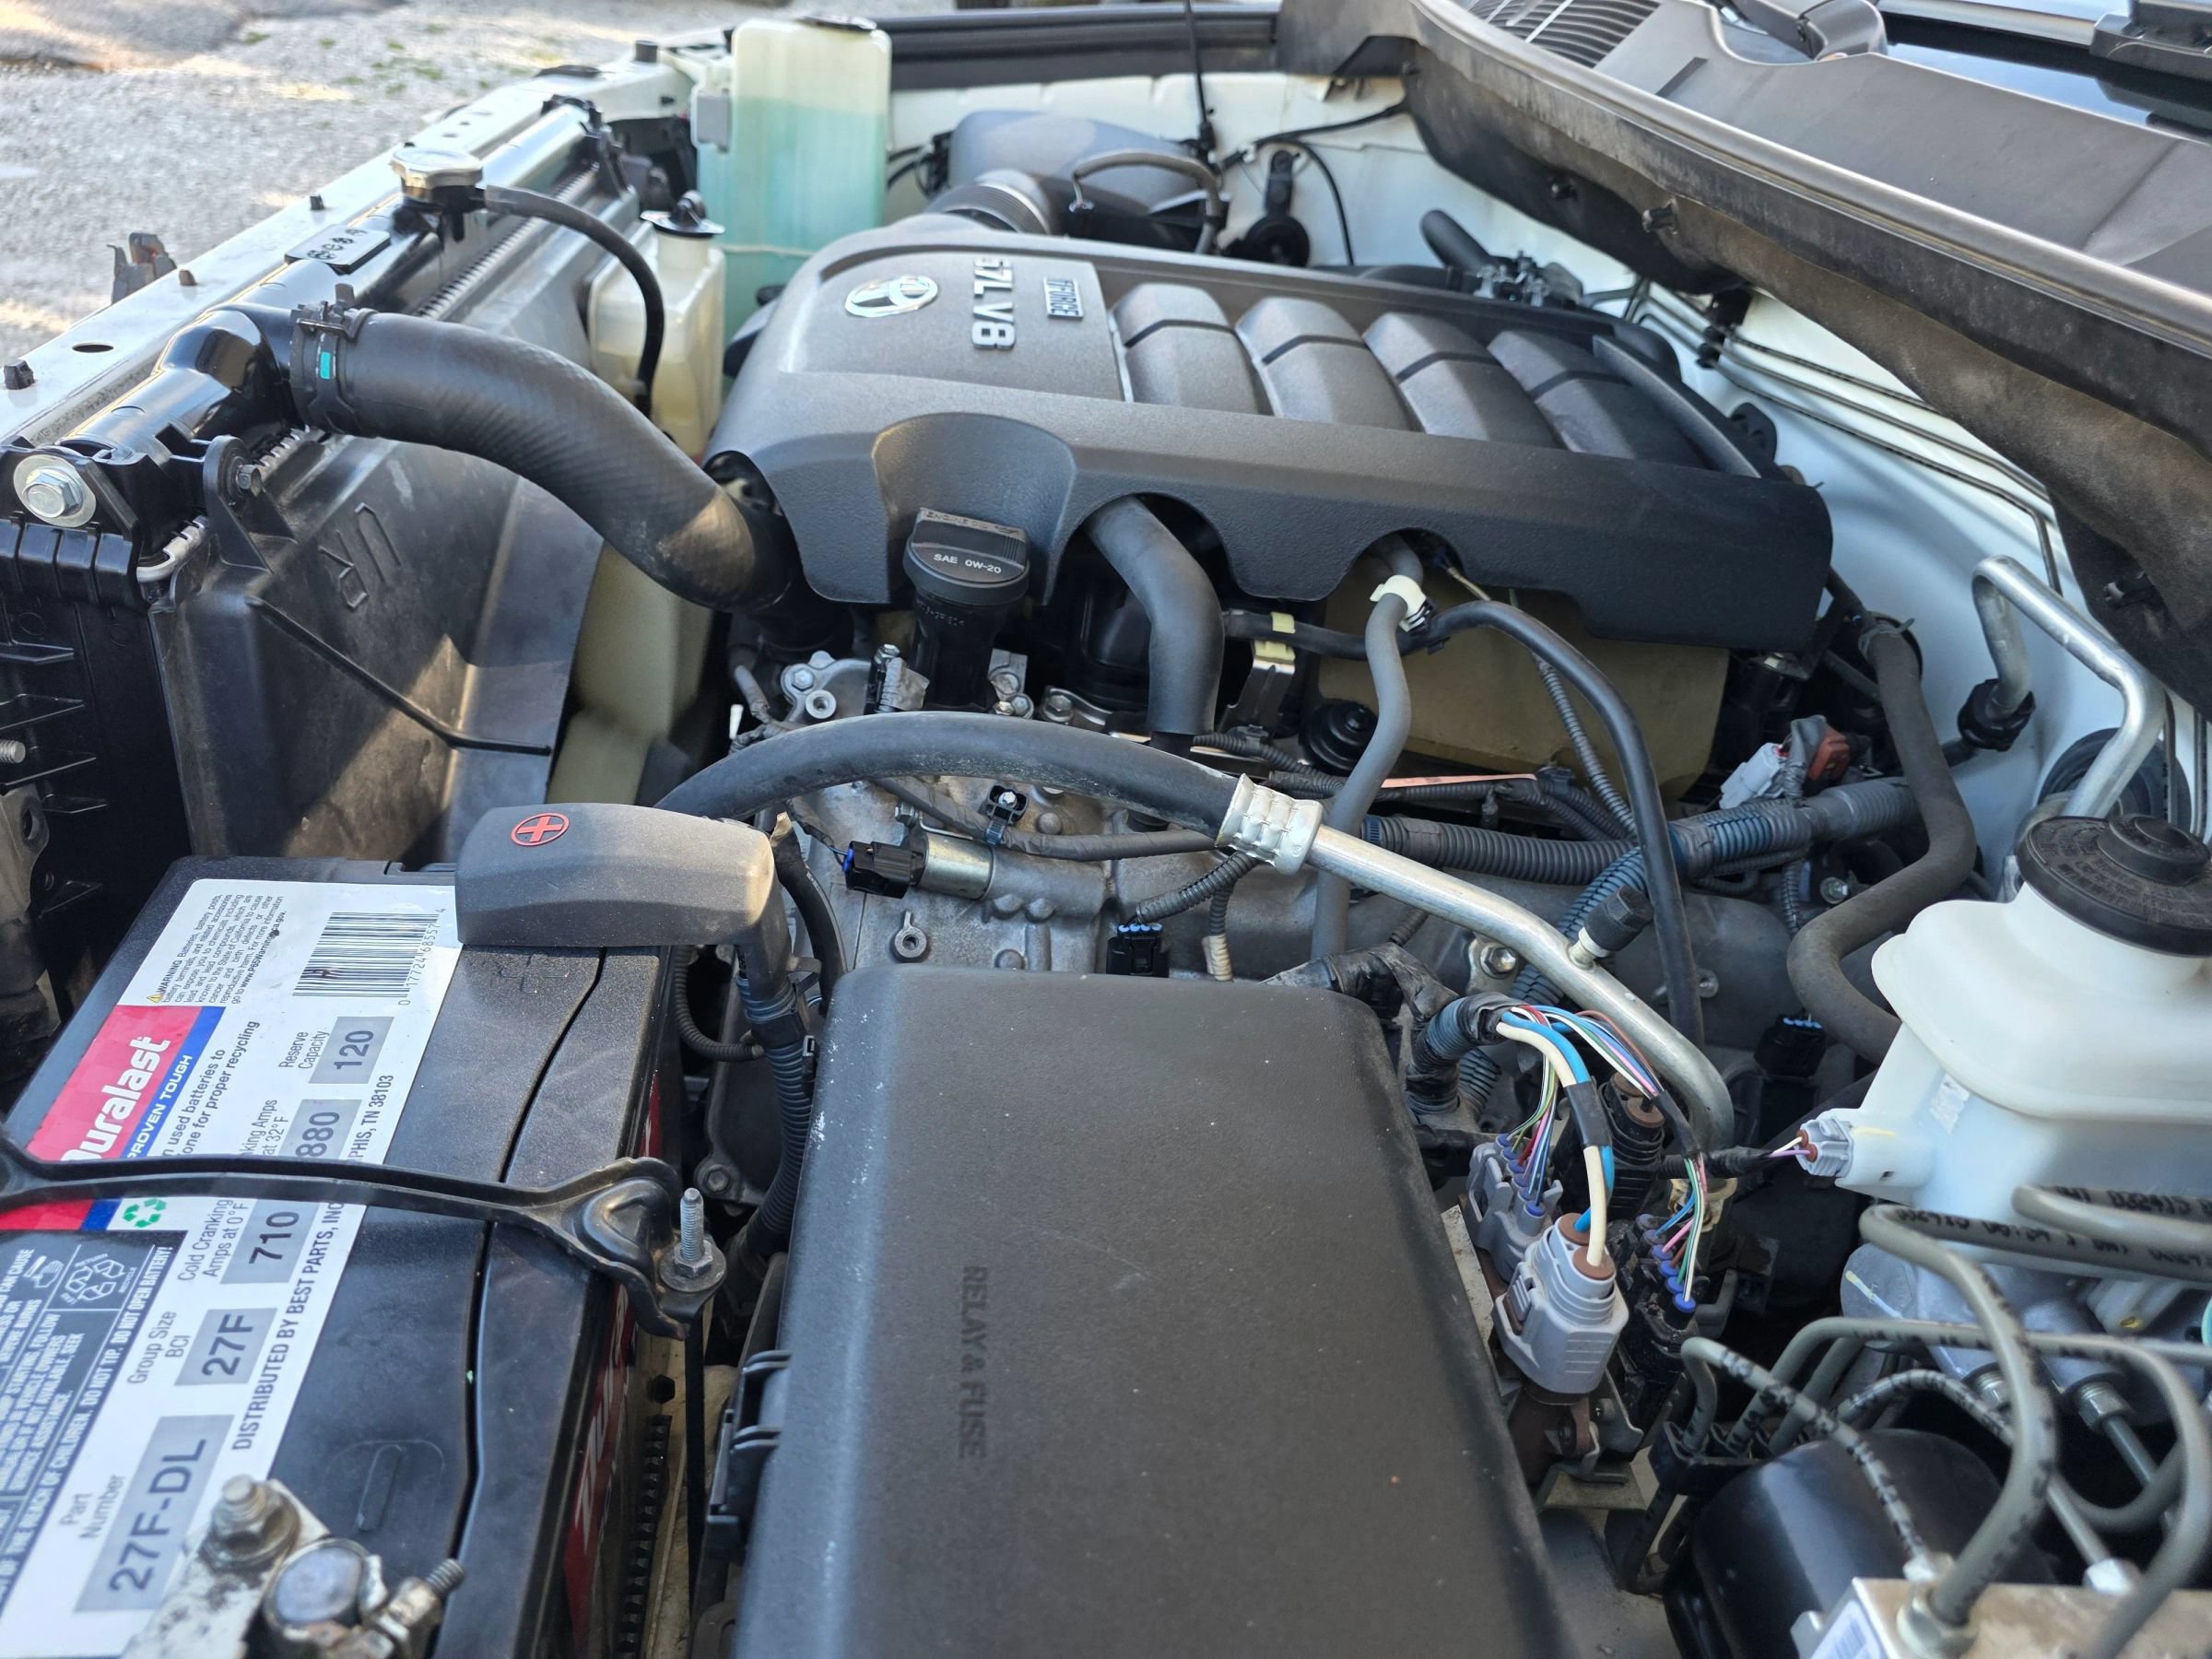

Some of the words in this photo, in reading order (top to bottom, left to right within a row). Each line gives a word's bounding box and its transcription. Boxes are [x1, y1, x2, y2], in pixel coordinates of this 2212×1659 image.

[971, 301, 1016, 349] V8
[934, 553, 958, 564] SAE
[964, 559, 1002, 574] 0W-20
[249, 895, 264, 911] cause
[262, 896, 285, 924] information
[155, 959, 182, 993] WARNING
[176, 932, 201, 958] Batteries,
[194, 912, 214, 930] battery
[206, 893, 224, 910] posts,
[160, 983, 182, 1002] battery
[173, 955, 197, 982] terminals,
[190, 943, 204, 954] and
[209, 894, 233, 923] accessories
[184, 989, 199, 1002] lead
[194, 976, 207, 987] and
[201, 960, 216, 972] lead
[210, 924, 238, 958] compounds,
[231, 905, 247, 921] which
[242, 894, 253, 903] are
[229, 918, 252, 943] California
[247, 940, 261, 950] For
[253, 925, 268, 939] more
[173, 991, 187, 1003] can
[182, 969, 202, 989] expose
[194, 956, 210, 967] you
[206, 919, 229, 946] chemicals
[222, 894, 245, 917] including
[207, 982, 226, 1003] cancer
[220, 967, 235, 978] and
[229, 949, 245, 962] birth
[240, 924, 259, 944] defects
[259, 895, 274, 909] other
[217, 950, 233, 965] State
[237, 952, 254, 968] harm.
[404, 957, 428, 986] 17724
[418, 924, 441, 952] 68557
[211, 966, 224, 975] the
[218, 969, 246, 1003] reproductive
[195, 982, 214, 1003] known
[230, 994, 243, 1004] go
[277, 1030, 310, 1067] Reserve
[296, 1030, 331, 1069] Capacity
[330, 1030, 376, 1070] 120
[158, 1054, 194, 1100] TOUGH
[190, 1110, 213, 1128] for
[203, 1071, 236, 1109] proper
[221, 1020, 262, 1068] recycling
[367, 1075, 394, 1107] 38103
[163, 1114, 193, 1145] used
[180, 1063, 220, 1112] batteries
[208, 1049, 227, 1060] to
[249, 1099, 281, 1128] Amps
[292, 1111, 342, 1157] 880
[359, 1110, 381, 1125] TN
[190, 1198, 235, 1250] Cranking
[246, 1210, 302, 1264] 710
[6, 1248, 36, 1274] CAUSE
[138, 1246, 174, 1286] BATTERY!
[175, 1253, 206, 1280] Cold
[200, 1241, 235, 1277] Amps
[218, 1227, 240, 1239] at
[300, 1226, 338, 1274] PARTS,
[126, 1287, 154, 1309] OPEN
[285, 1277, 316, 1313] BEST
[960, 1265, 990, 1352] RELAY
[28, 1312, 62, 1347] FOLLOW
[110, 1330, 133, 1343] DO
[117, 1311, 143, 1328] NOT
[275, 1318, 300, 1338] BY
[60, 1332, 86, 1353] SEEK
[98, 1347, 124, 1366] TIP.
[125, 1342, 165, 1383] Group
[147, 1311, 179, 1339] Size
[163, 1335, 192, 1357] BCI
[197, 1313, 260, 1376] 27F
[88, 1367, 114, 1387] NOT
[960, 1353, 987, 1373] &
[78, 1389, 103, 1406] DO
[230, 1343, 290, 1450] DISTRIBUTED
[958, 1380, 988, 1459] FUSE
[47, 1408, 95, 1468] CHILDREN.
[57, 1492, 93, 1525] Part
[77, 1475, 127, 1538] Number
[103, 1438, 207, 1592] 27F-DL
